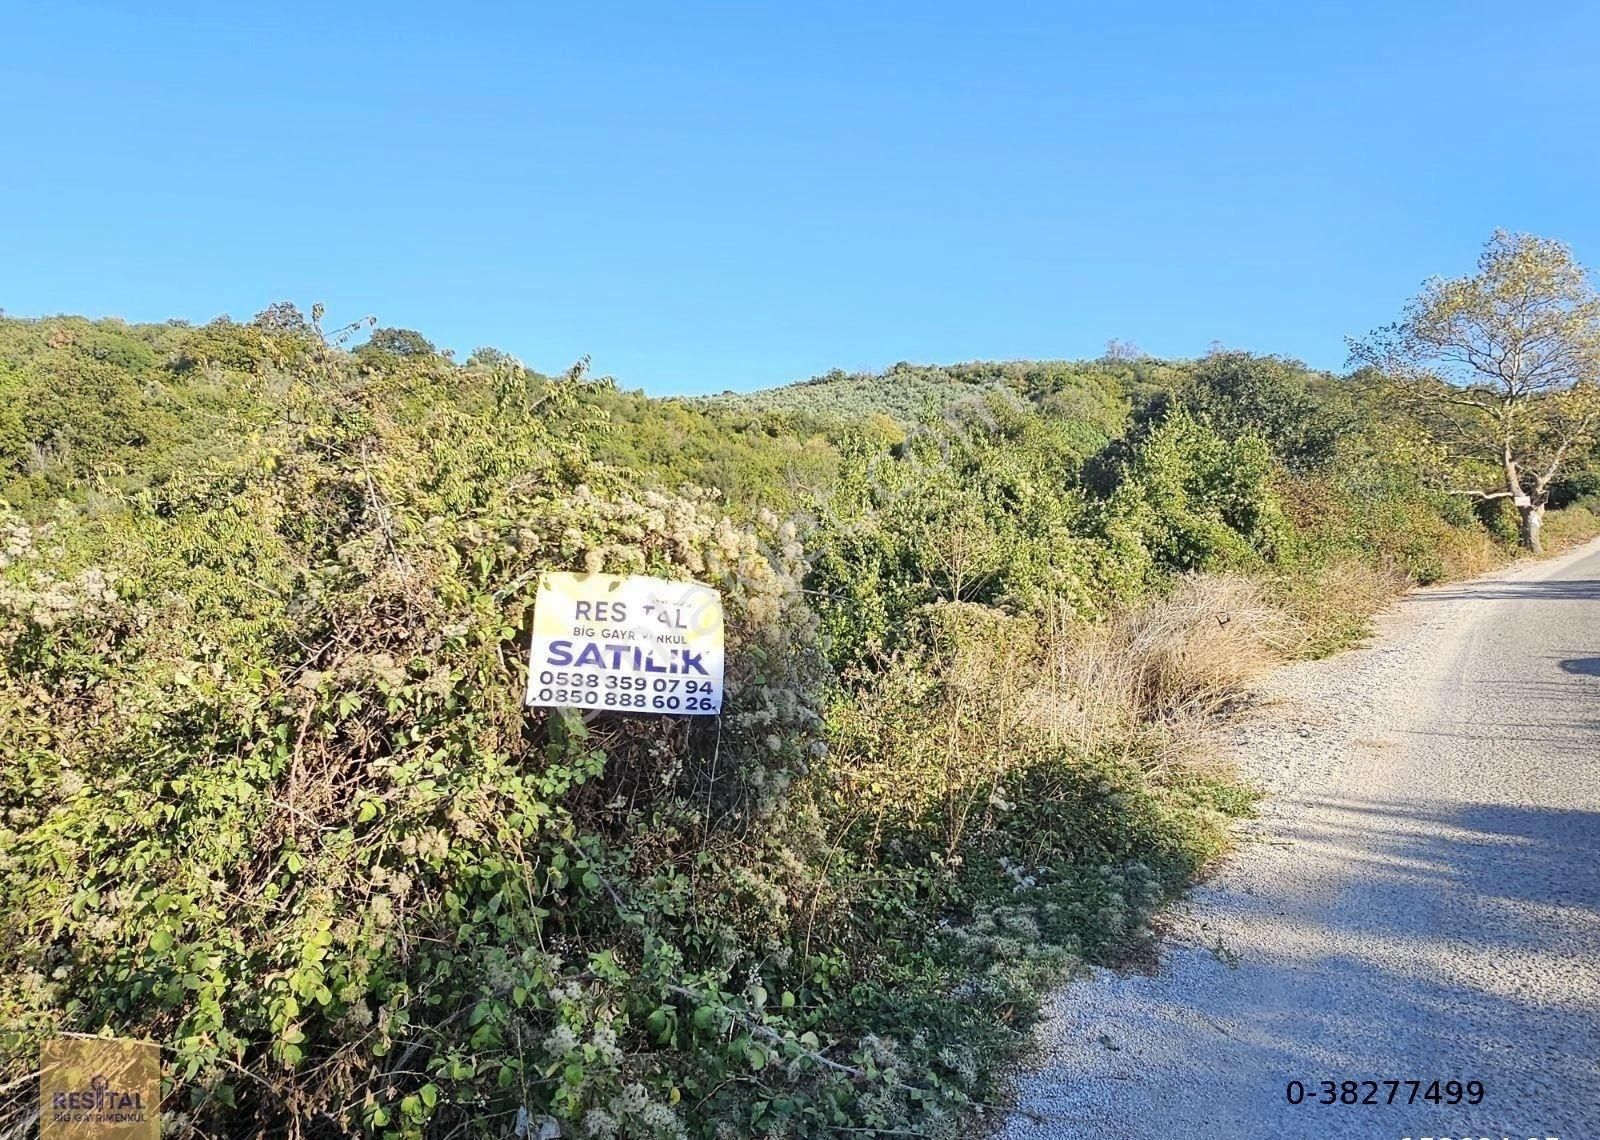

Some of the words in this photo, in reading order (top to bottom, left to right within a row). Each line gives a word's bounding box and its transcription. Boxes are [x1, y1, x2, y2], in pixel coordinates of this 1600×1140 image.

[546, 640, 709, 676] SATILIK
[539, 671, 599, 689] 0538
[605, 675, 647, 691] 359
[653, 678, 680, 693] 07
[685, 680, 713, 695] 94
[539, 688, 598, 703] 0850
[604, 692, 646, 708] 888
[652, 696, 680, 710] 60
[685, 697, 712, 711] 26
